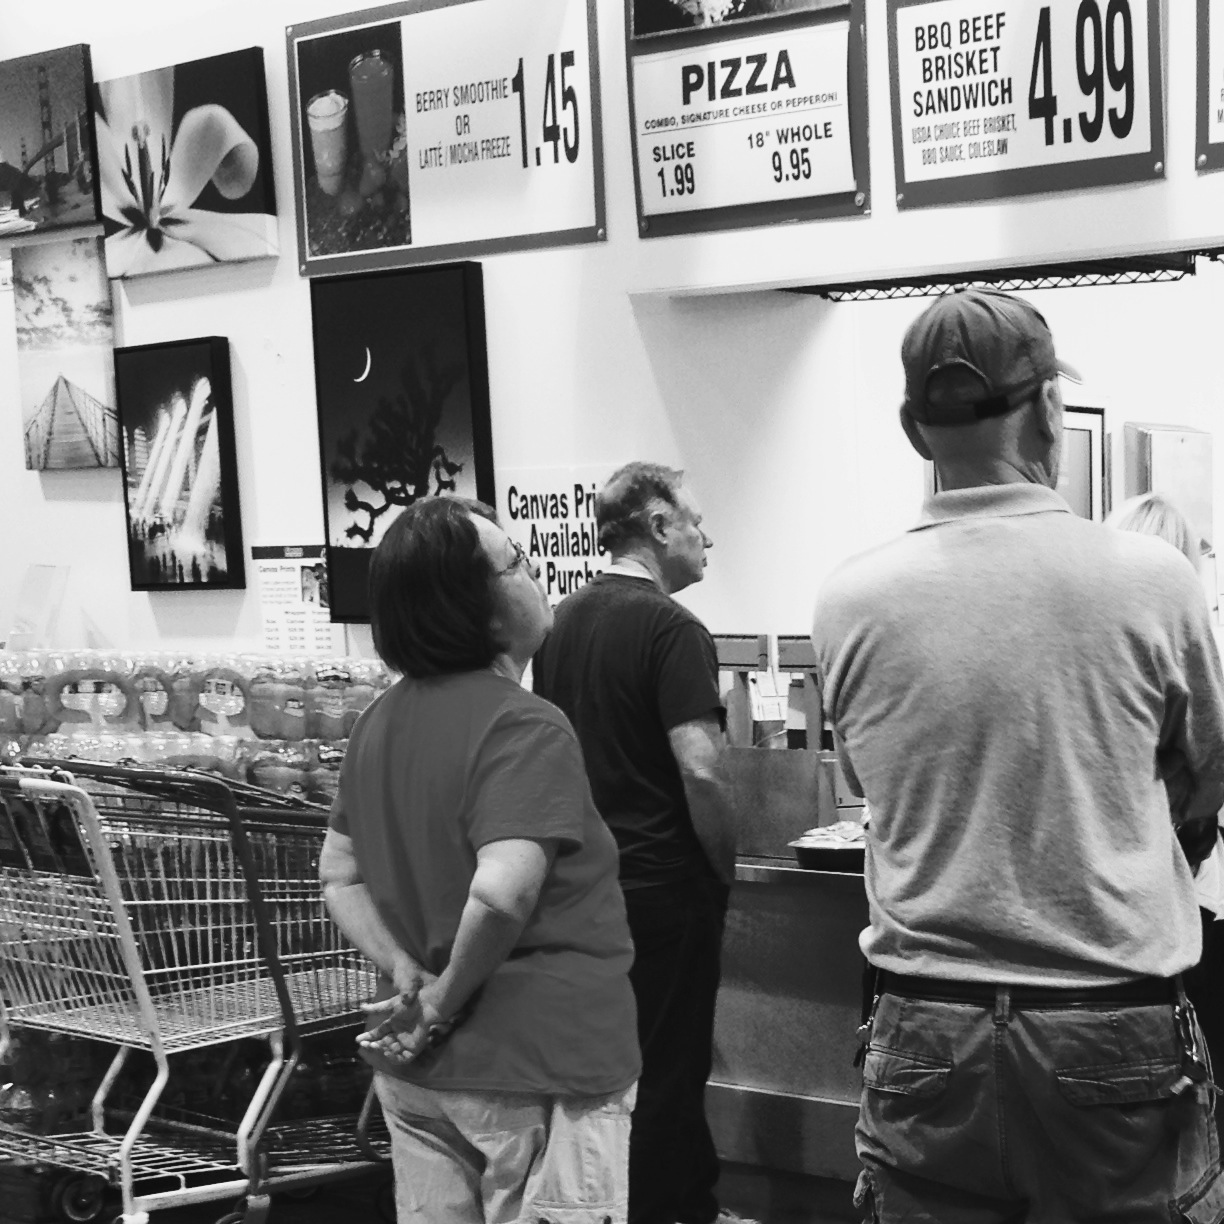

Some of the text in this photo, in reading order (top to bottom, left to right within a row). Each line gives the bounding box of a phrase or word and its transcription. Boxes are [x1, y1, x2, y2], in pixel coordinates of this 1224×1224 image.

[915, 12, 1006, 52] BBQ BEEF
[681, 49, 796, 105] PIZZA
[922, 46, 1000, 83] BRISKET
[1028, 0, 1135, 146] 4.99
[416, 77, 509, 113] BERRY SMOOTHIE
[512, 50, 580, 168] 1.45
[644, 92, 838, 130] COMBO, SIGNATURE CHEESE OR PEPPERONI
[912, 77, 1013, 117] SANDWICH
[455, 114, 470, 136] OR
[776, 122, 833, 145] WHOLE
[450, 142, 478, 166] MOCHA
[481, 136, 511, 162] FREEZE
[653, 142, 695, 162] SLICE
[772, 148, 812, 183] 9.95
[657, 163, 695, 197] 1.99
[508, 483, 596, 520] Canvas Pri
[546, 561, 603, 595] Purch
